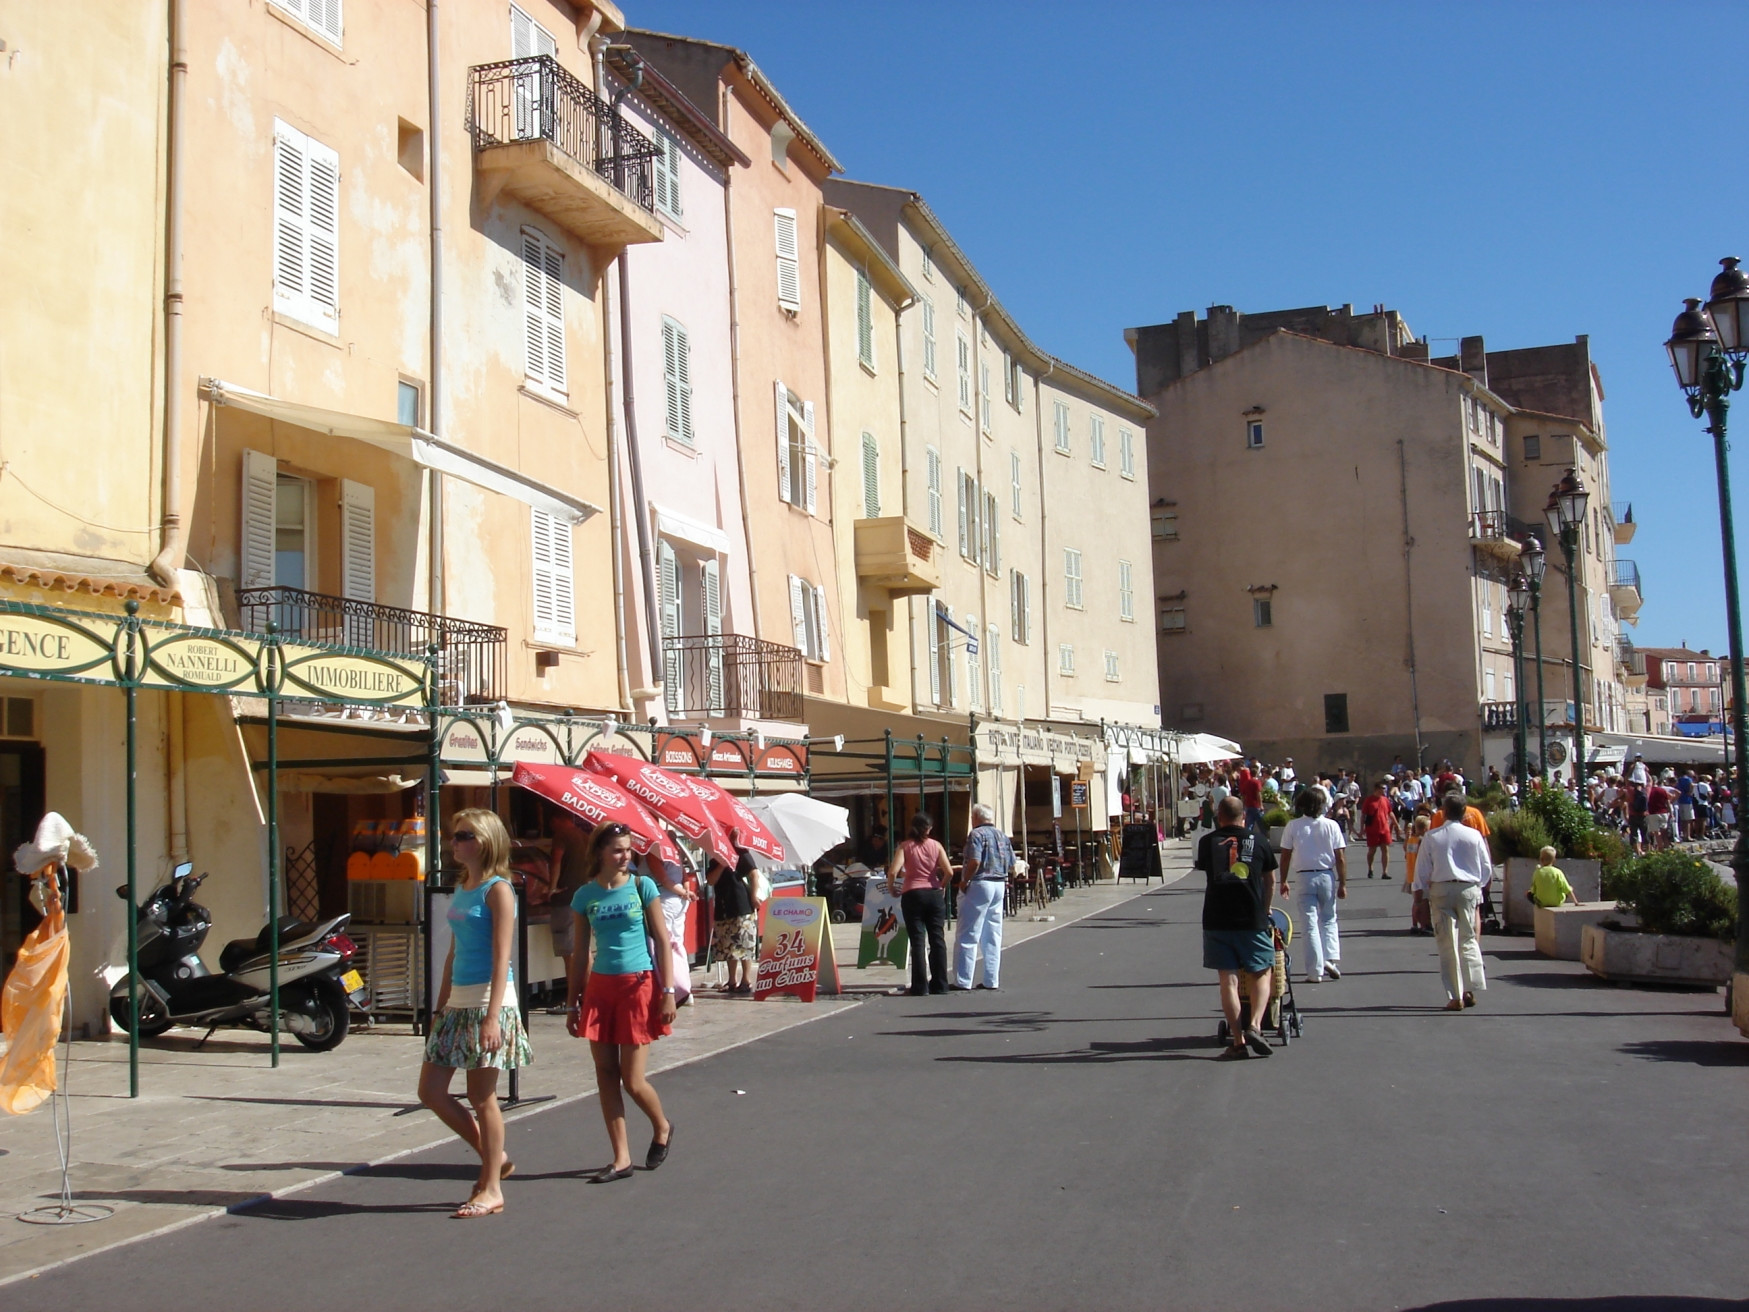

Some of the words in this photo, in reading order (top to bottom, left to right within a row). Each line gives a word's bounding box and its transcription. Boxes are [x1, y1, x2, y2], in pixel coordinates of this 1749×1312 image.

[187, 645, 218, 656] ROBERT
[166, 653, 237, 673] NANNELLI
[183, 669, 222, 681] ROMUALD
[307, 665, 403, 694] IMMOBILIERE
[665, 750, 693, 764] BOISSONS
[626, 779, 666, 808] BADOIT
[561, 791, 607, 821] BADOIT
[774, 928, 805, 958] 34
[775, 968, 817, 987] Choix
